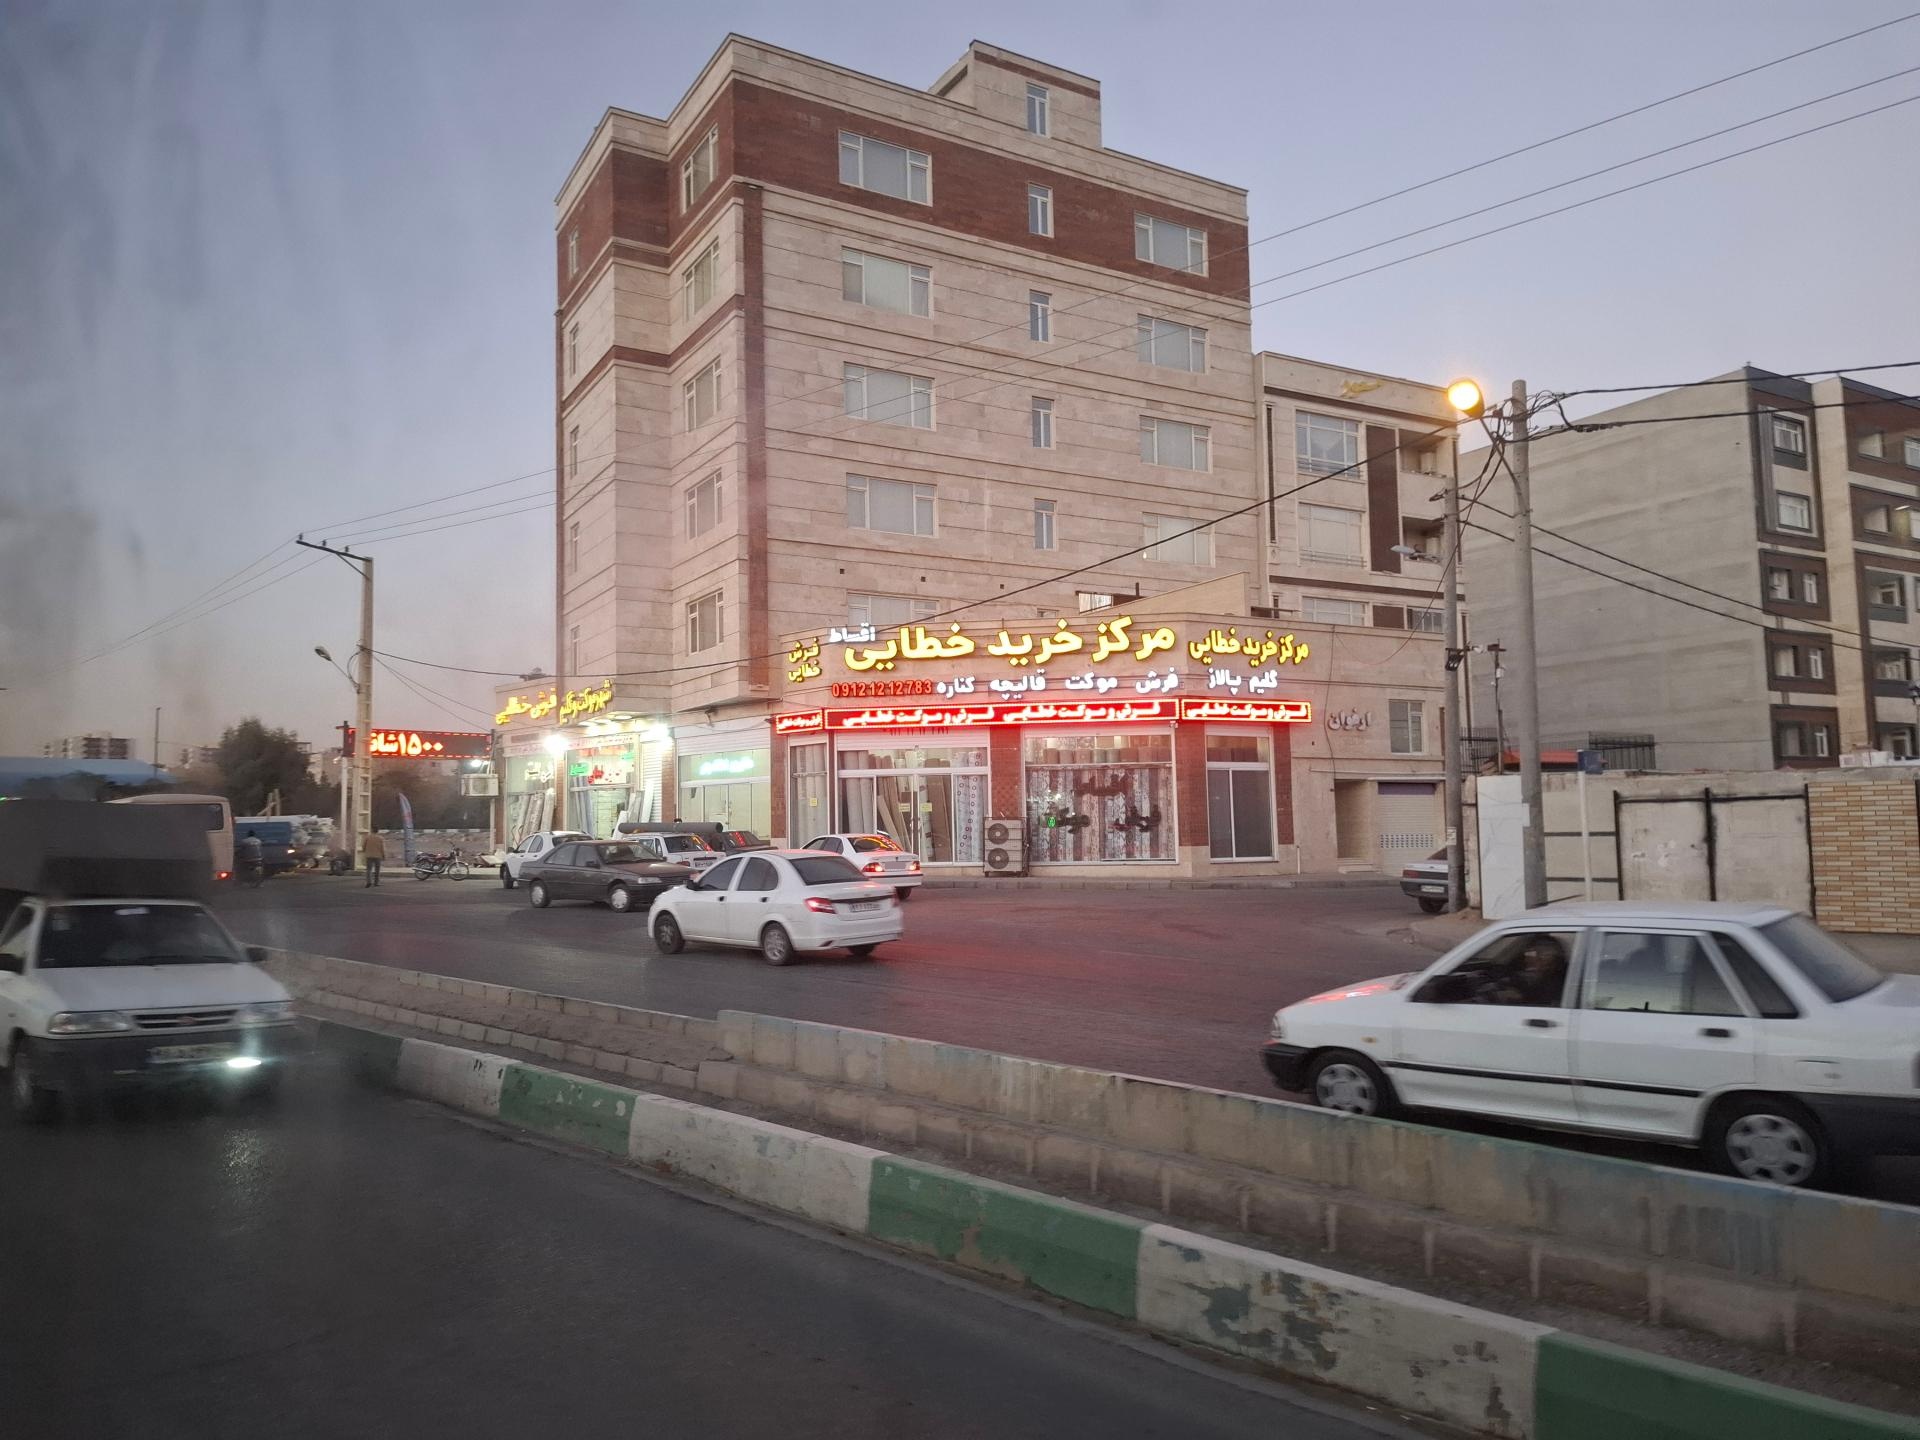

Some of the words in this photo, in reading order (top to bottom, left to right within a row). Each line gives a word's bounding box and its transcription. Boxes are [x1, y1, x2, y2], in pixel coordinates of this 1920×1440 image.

[828, 622, 877, 643] اقساط
[987, 618, 1083, 666] خرید
[1092, 616, 1176, 662] مرکز
[1189, 628, 1241, 664] خطایی
[788, 638, 821, 663] فرش
[844, 622, 976, 671] خطایی
[1243, 631, 1278, 666] خرید
[1279, 634, 1309, 664] مرکز
[788, 660, 822, 682] خطایی
[989, 668, 1046, 700] قالیچه
[1065, 672, 1118, 693] موکت
[1135, 667, 1179, 694] فرش
[1208, 667, 1242, 695] پالاز
[1249, 669, 1278, 693] گلیم
[832, 679, 932, 698] 09121212783
[936, 676, 975, 698] کناره
